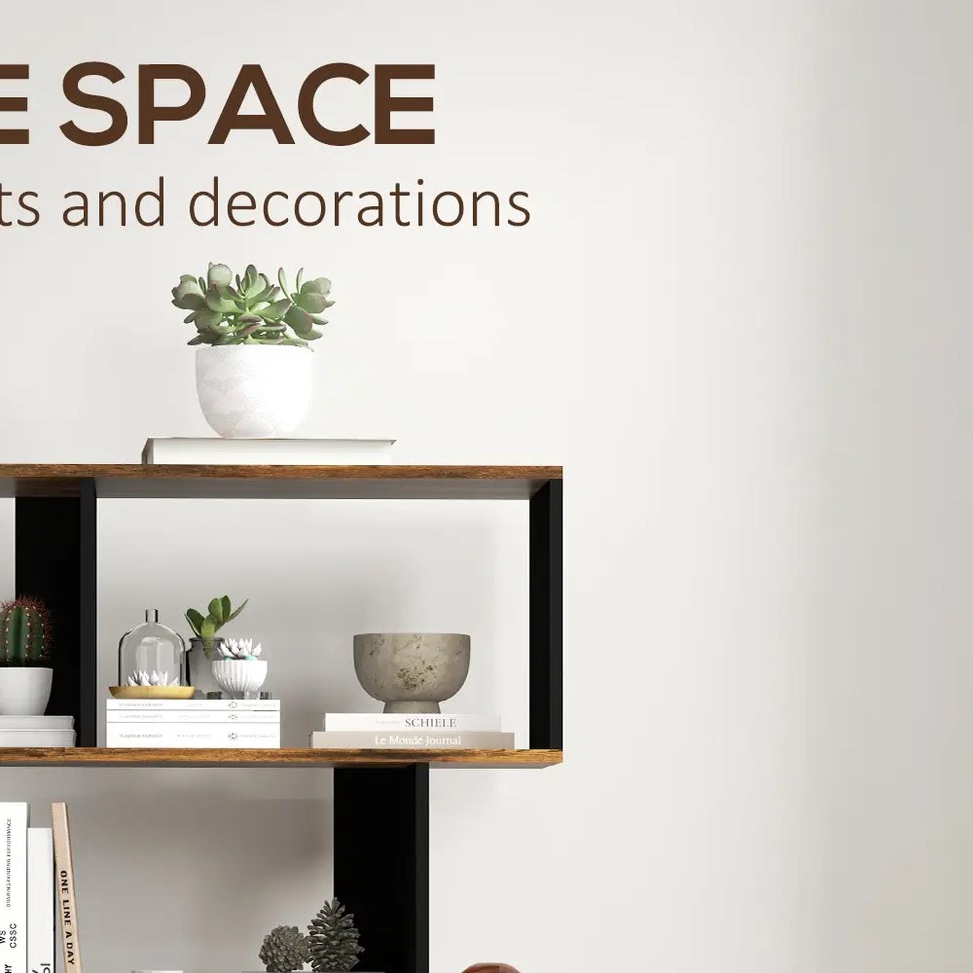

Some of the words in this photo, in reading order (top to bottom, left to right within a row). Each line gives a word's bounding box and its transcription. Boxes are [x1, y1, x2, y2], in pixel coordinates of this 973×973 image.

[404, 718, 458, 728] SCHIELE
[375, 736, 386, 745] Le
[389, 736, 423, 745] Monde
[425, 735, 461, 747] Journal
[60, 870, 69, 894] ONE
[62, 900, 71, 926] LINE
[0, 930, 6, 944] WS
[9, 923, 17, 948] CSSC
[65, 931, 72, 939] A
[67, 942, 75, 965] DAY
